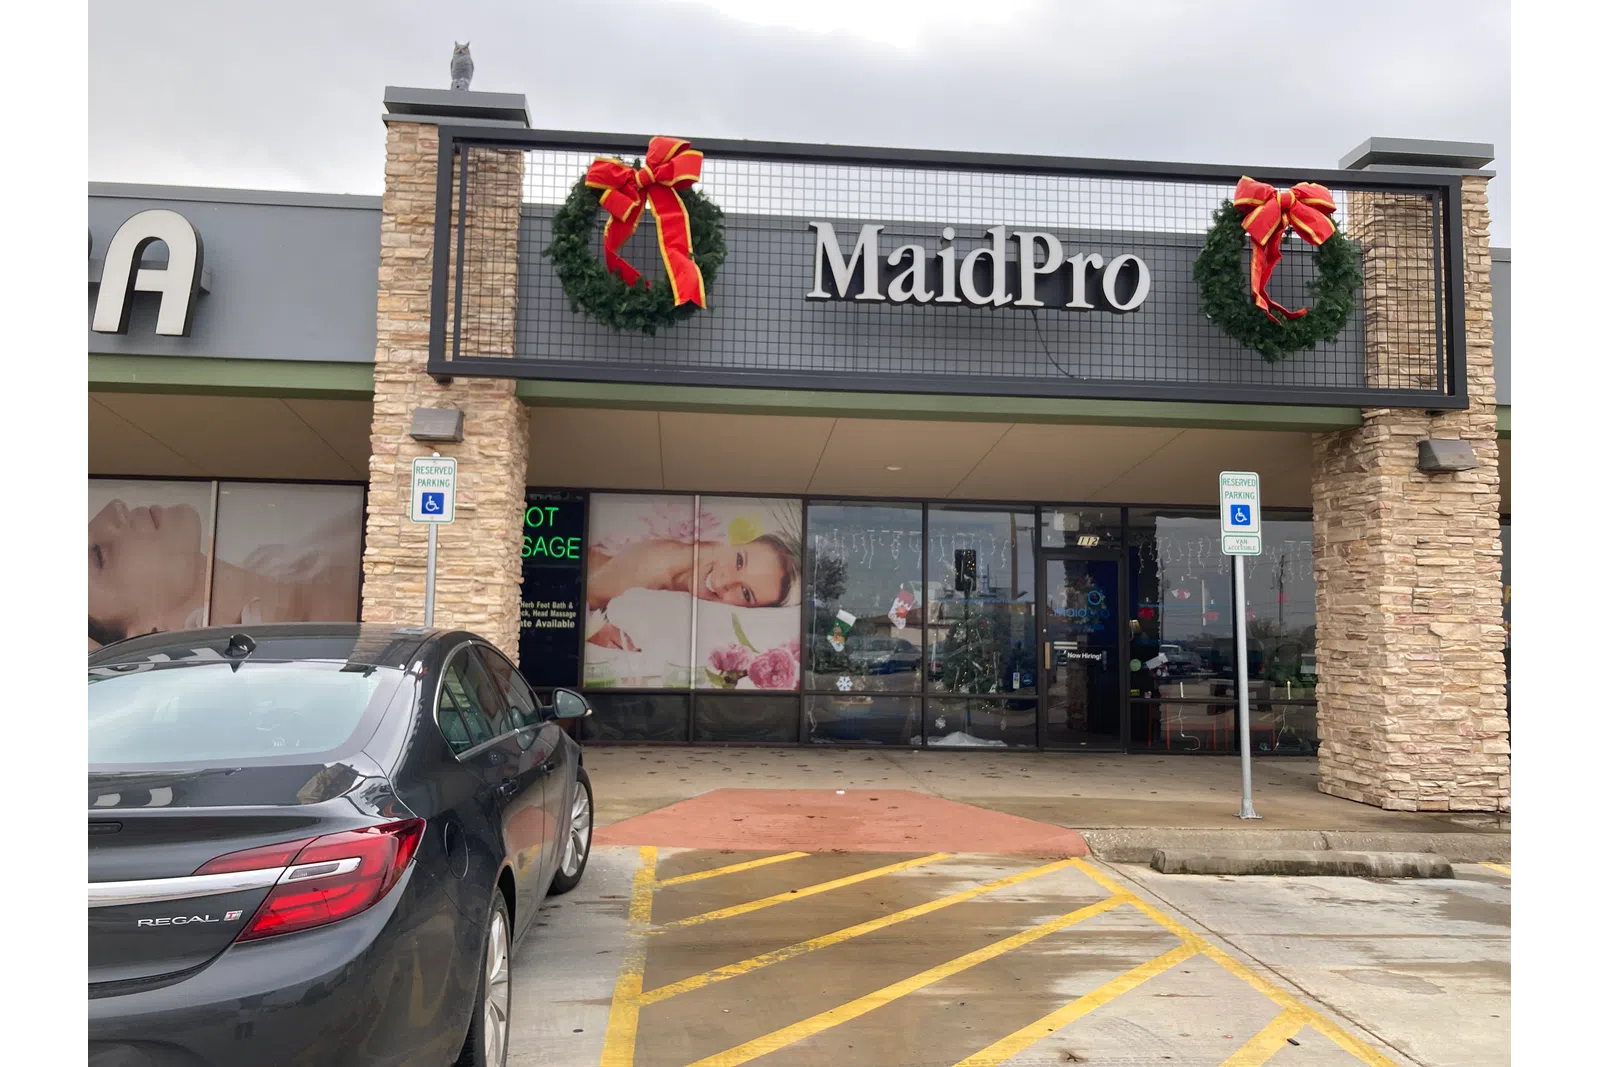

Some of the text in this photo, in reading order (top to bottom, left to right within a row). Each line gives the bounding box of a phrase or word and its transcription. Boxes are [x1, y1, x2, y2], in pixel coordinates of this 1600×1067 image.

[806, 220, 1151, 312] MaidPro
[88, 208, 204, 337] A
[415, 466, 453, 475] RESERVED
[417, 479, 450, 487] PARKING
[1222, 478, 1256, 487] RESERVED
[1224, 491, 1255, 500] PARKING
[524, 506, 560, 528] OT
[1080, 537, 1098, 545] 112
[536, 601, 550, 609] Foot
[552, 601, 566, 609] Bath
[550, 610, 577, 619] Massage
[535, 619, 576, 628] Available
[1081, 652, 1102, 661] Hiring!
[137, 914, 220, 928] REGAL
